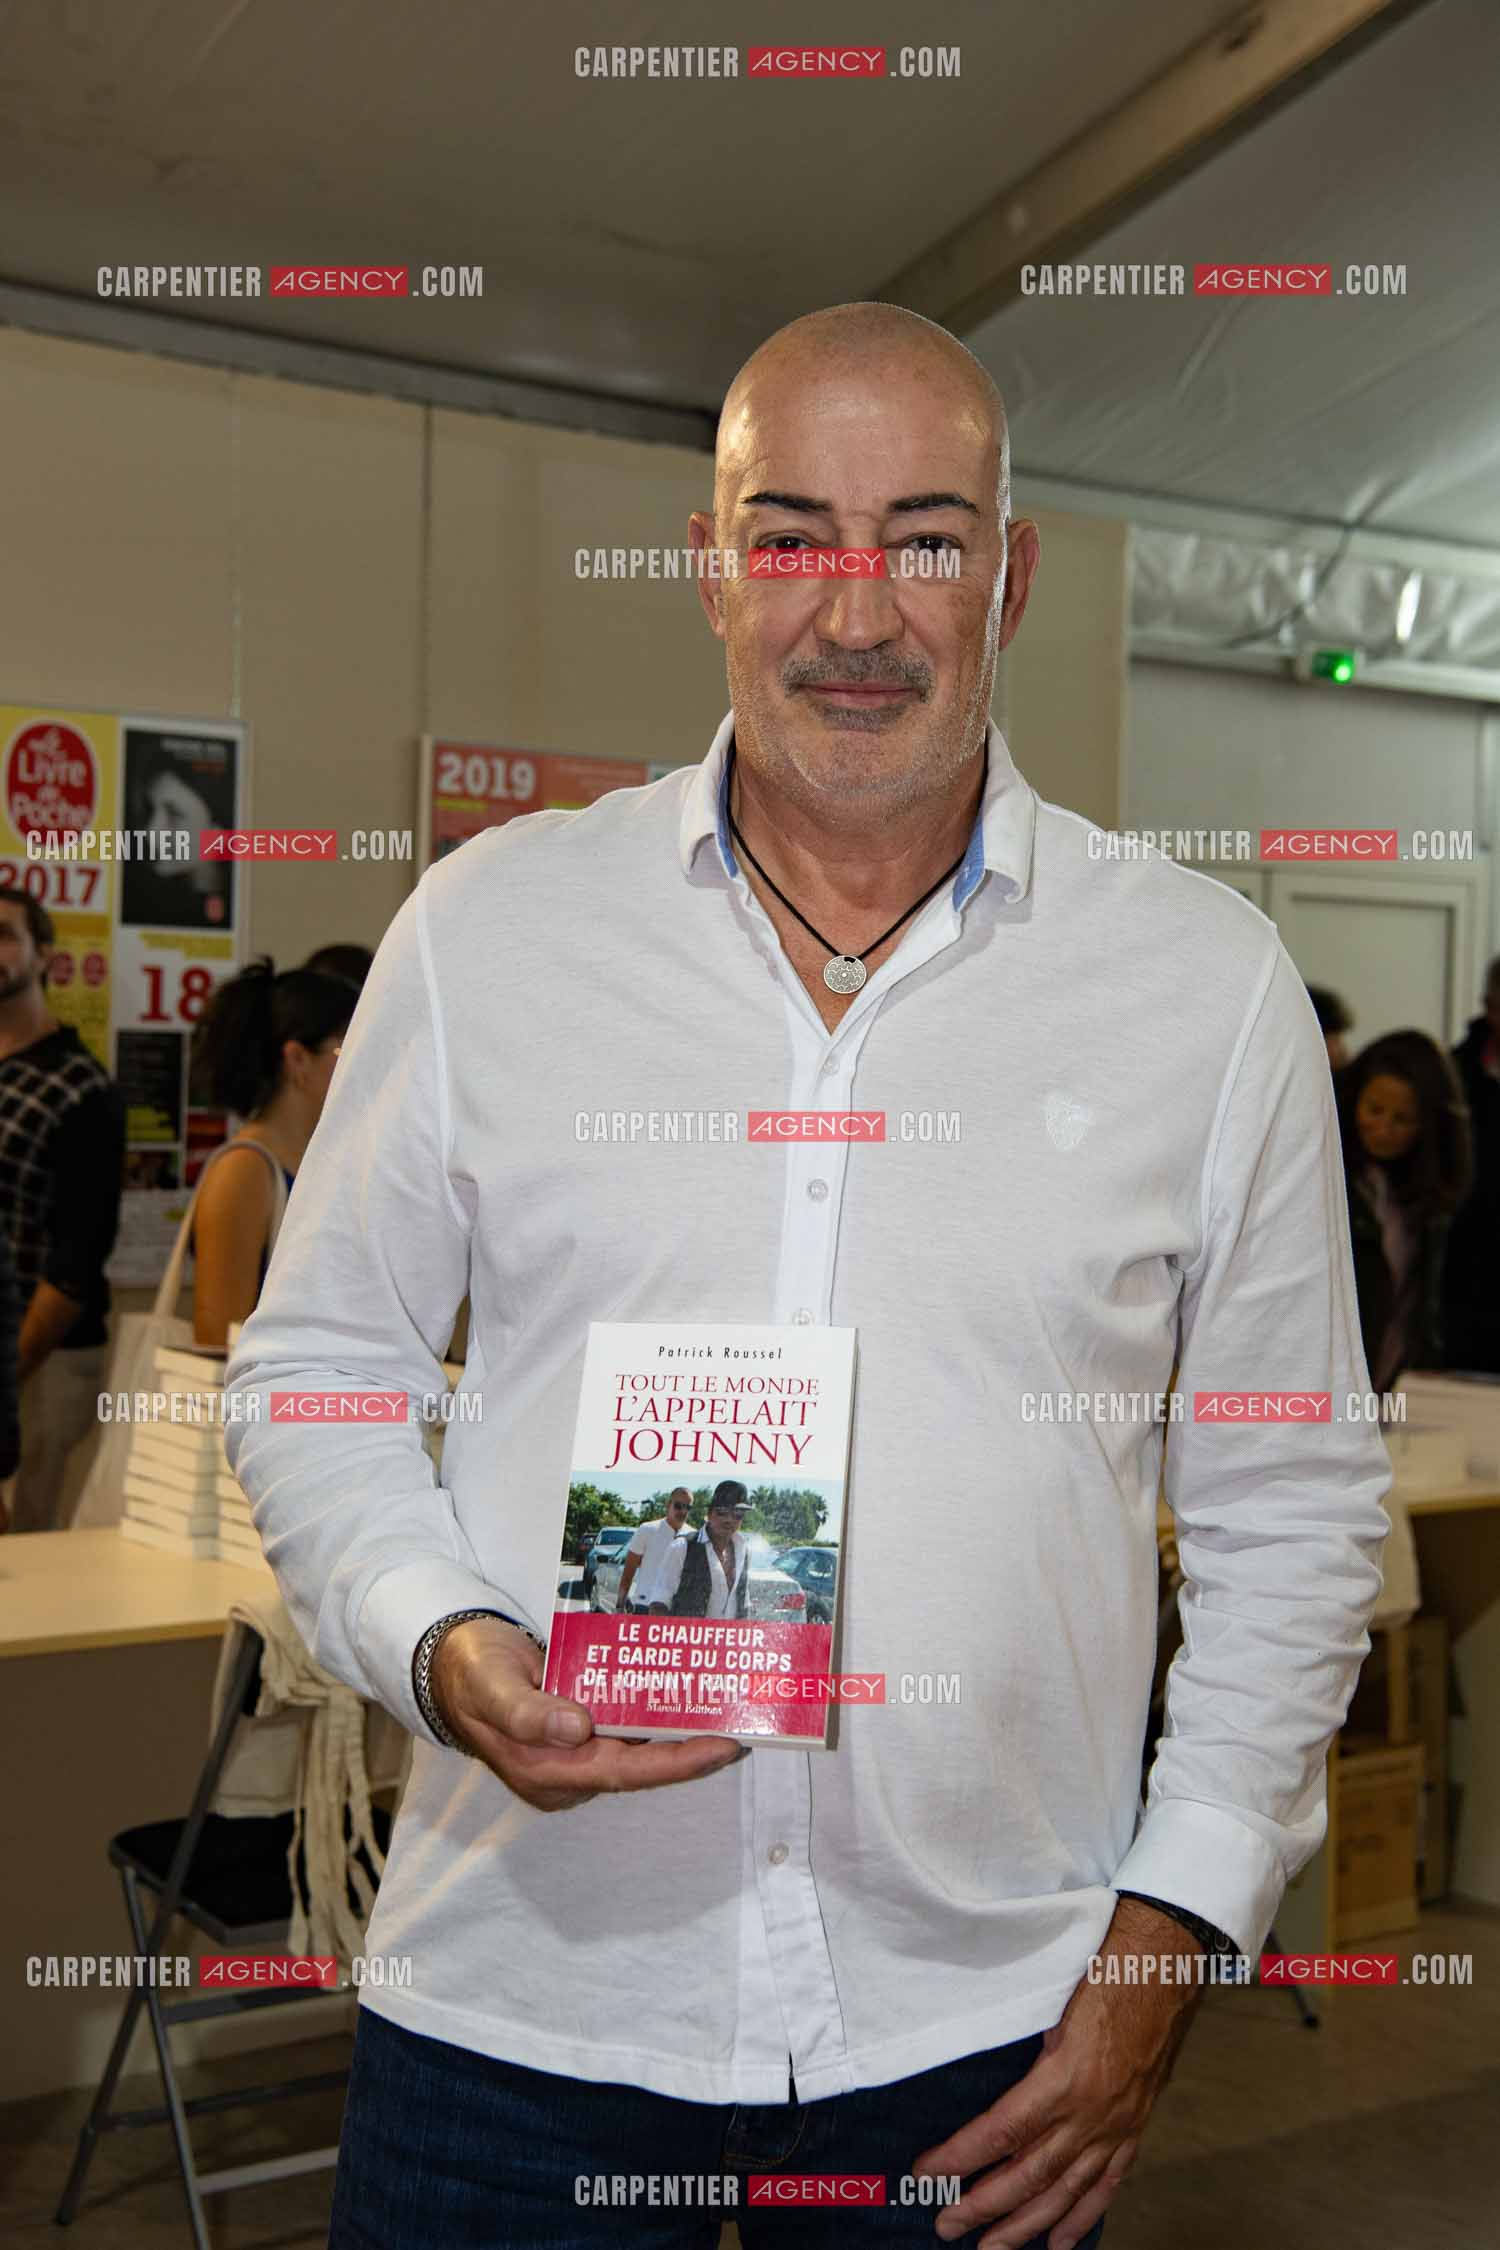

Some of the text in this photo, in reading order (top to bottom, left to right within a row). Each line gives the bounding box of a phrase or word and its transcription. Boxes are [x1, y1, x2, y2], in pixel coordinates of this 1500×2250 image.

[437, 751, 536, 800] 2019
[139, 963, 214, 1024] 18
[658, 1345, 783, 1360] Patrick Roussel
[615, 1373, 820, 1396] TOUT LE MONDE
[612, 1396, 818, 1426] L'APPELAIT
[604, 1427, 814, 1469] JOHNNY
[618, 1623, 765, 1648] LE CHAUFFEUR
[587, 1644, 792, 1672] ET GARDE DU CORPS
[583, 1668, 608, 1687] DE
[614, 1669, 694, 1690] JOHNNY
